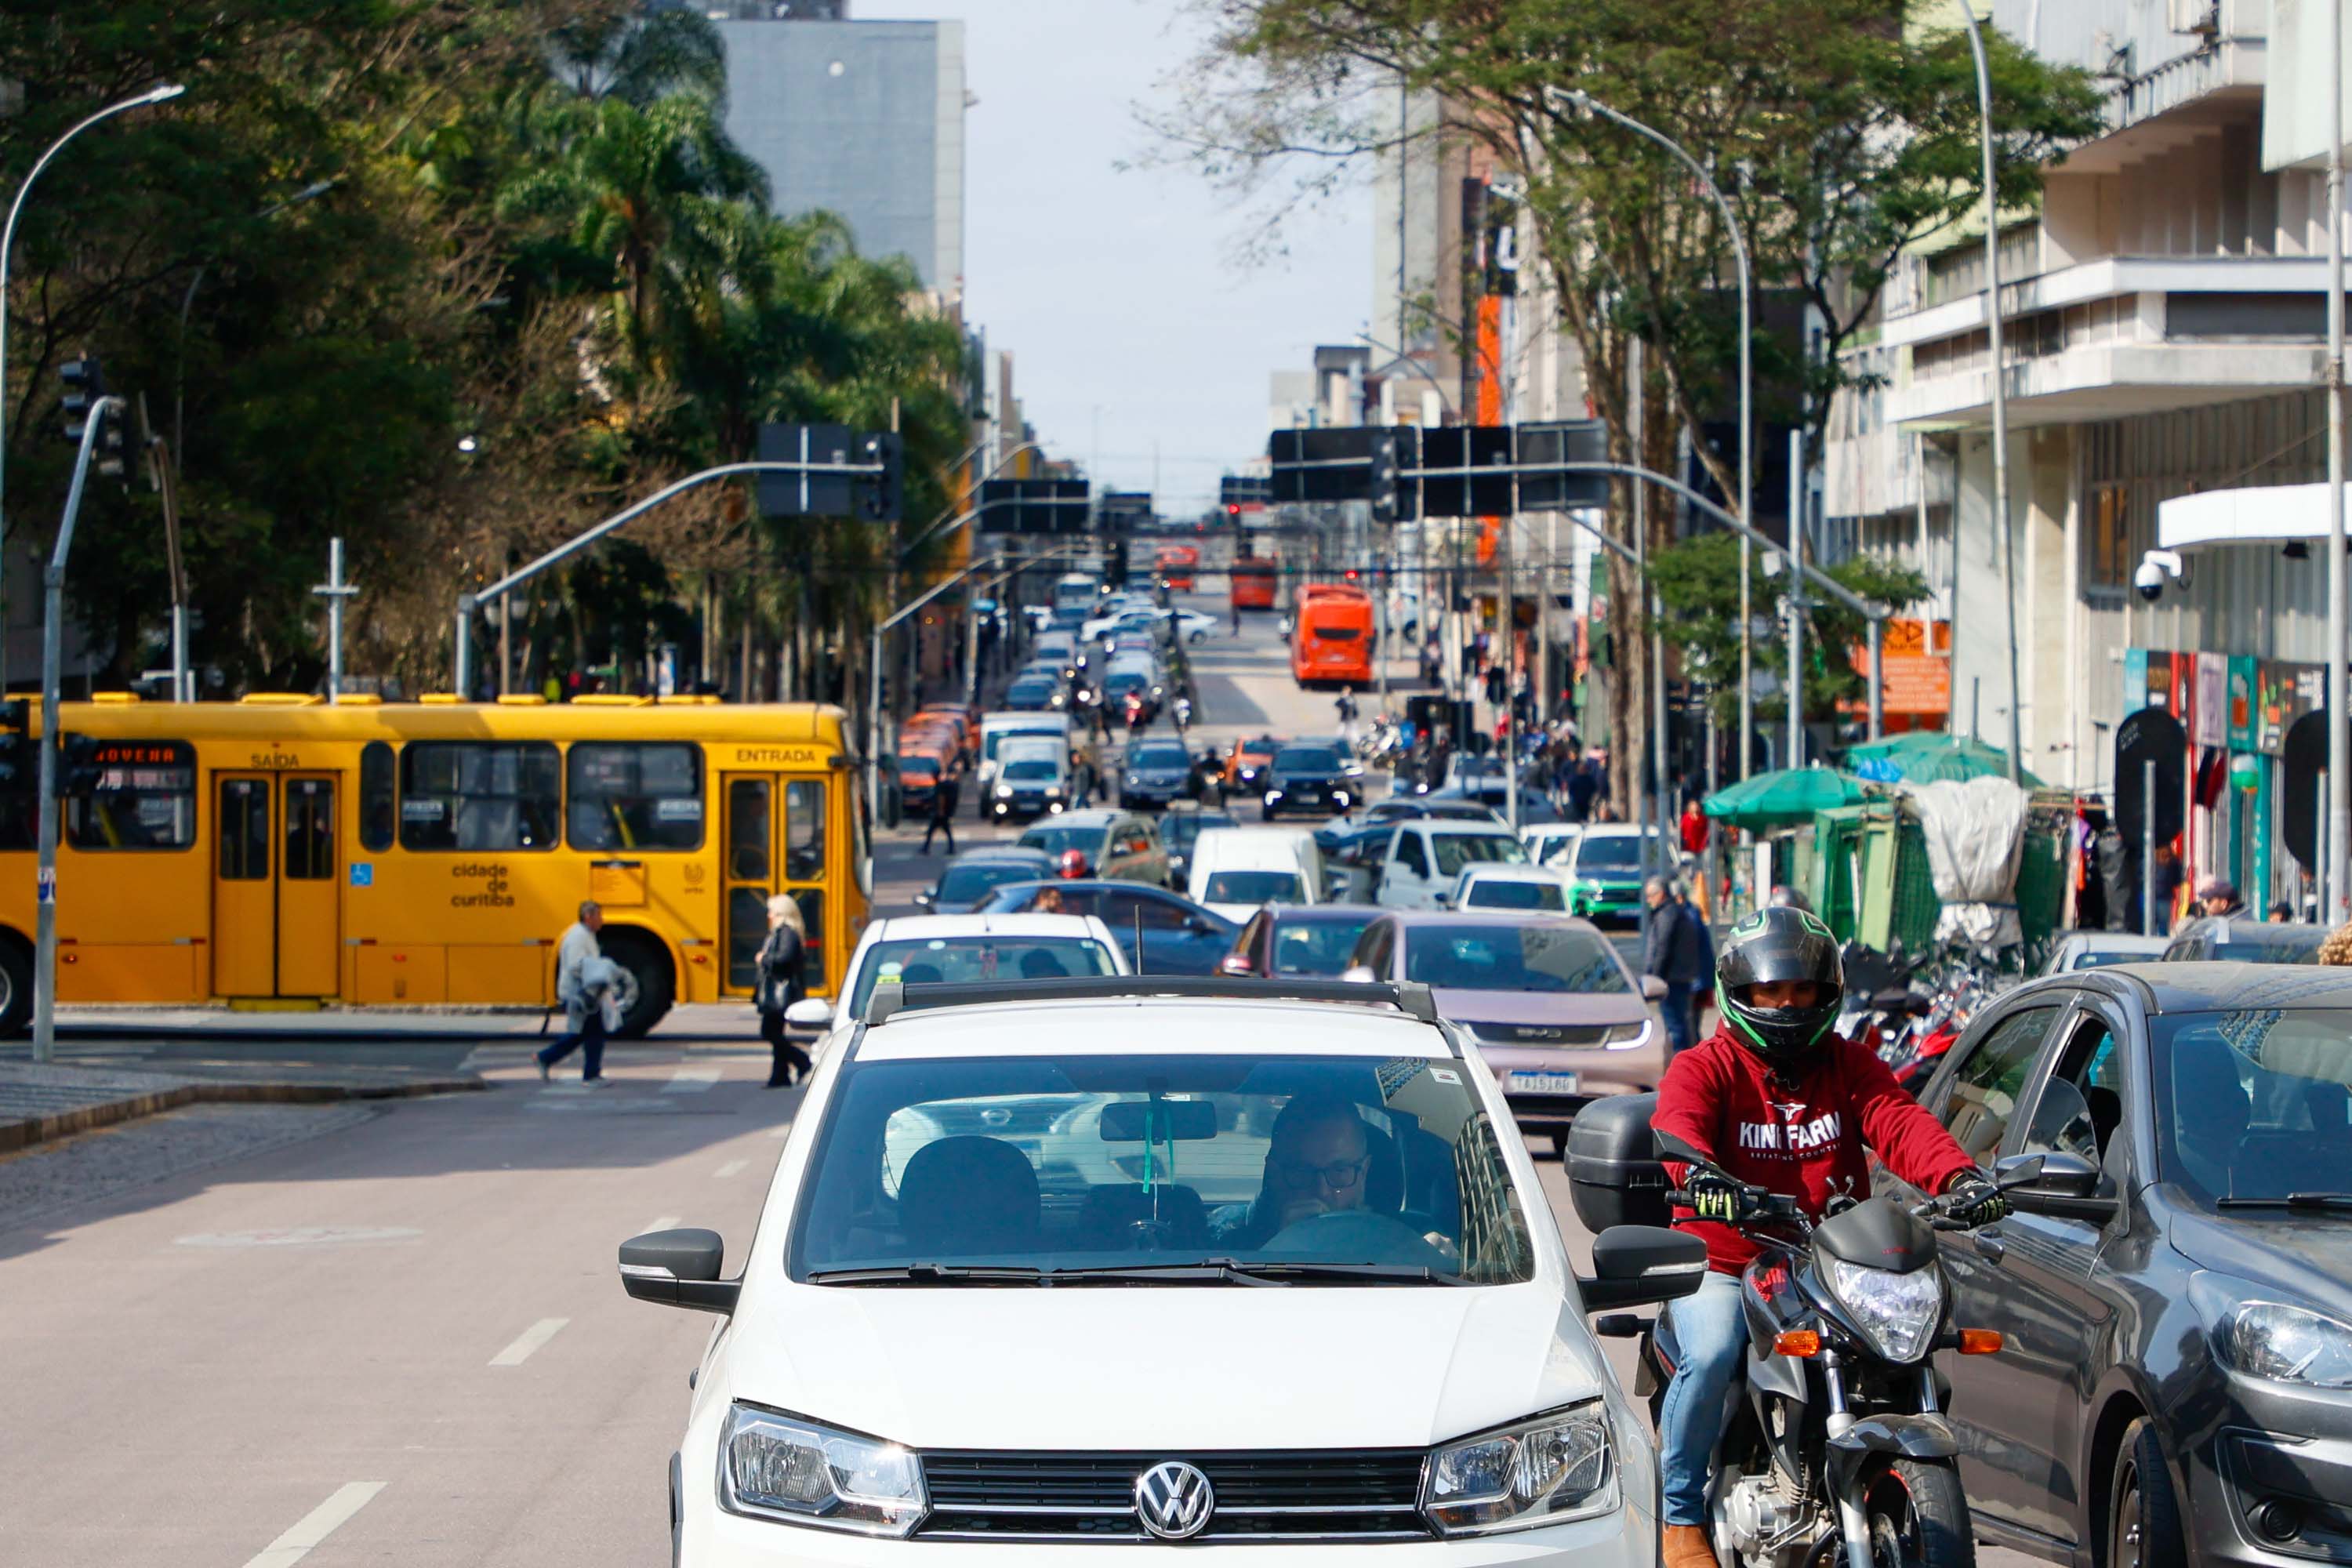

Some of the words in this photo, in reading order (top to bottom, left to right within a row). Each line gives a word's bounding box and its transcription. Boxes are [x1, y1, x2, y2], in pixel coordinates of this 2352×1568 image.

[251, 752, 299, 768] SAÍDA
[737, 749, 815, 762] ENTRADA
[452, 864, 508, 877] cidade
[487, 877, 508, 892] de
[451, 893, 515, 908] curitiba
